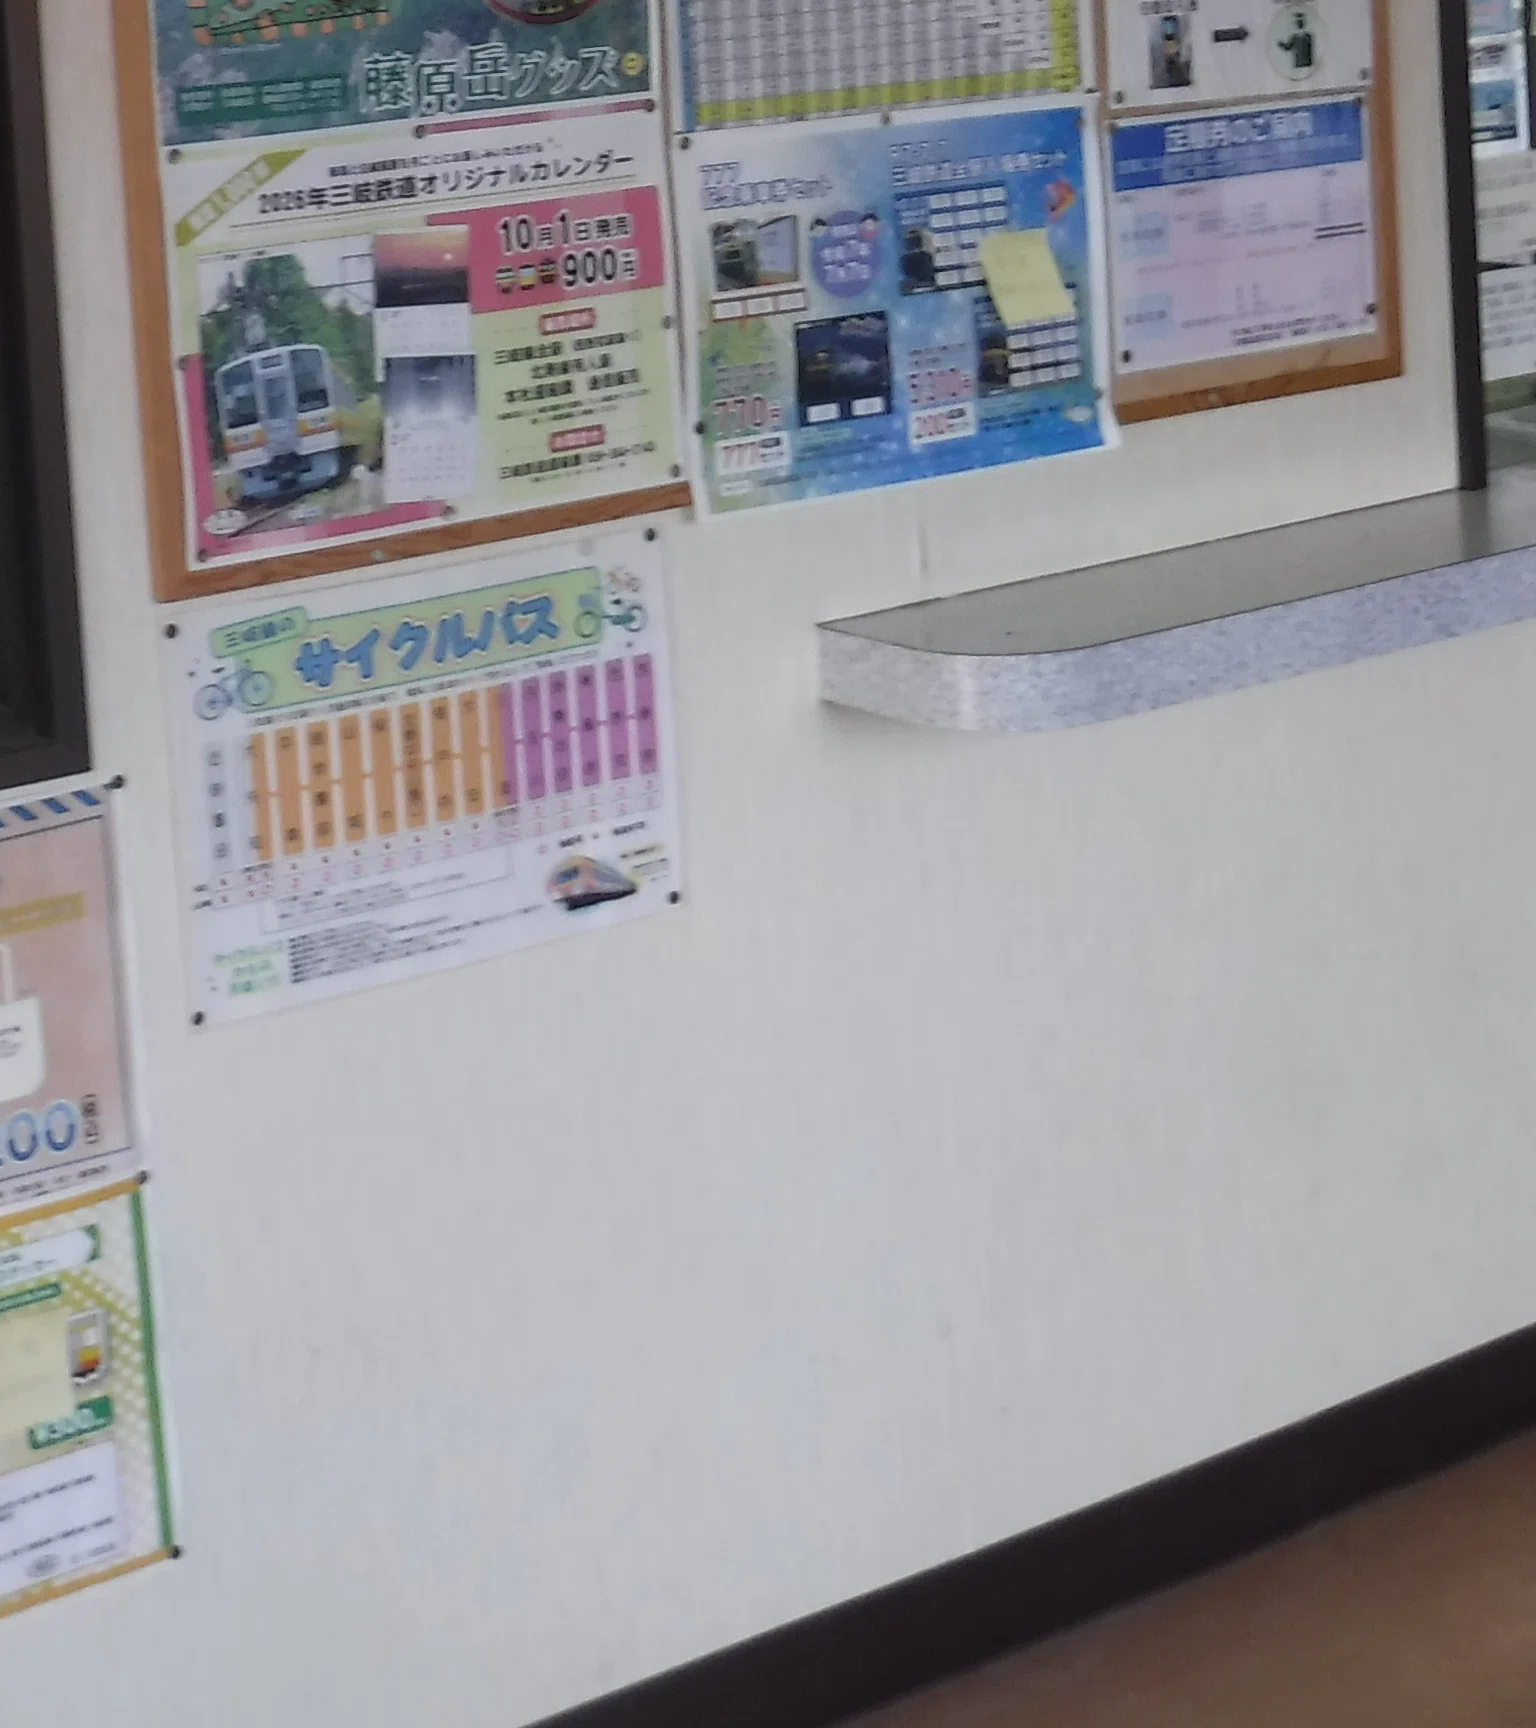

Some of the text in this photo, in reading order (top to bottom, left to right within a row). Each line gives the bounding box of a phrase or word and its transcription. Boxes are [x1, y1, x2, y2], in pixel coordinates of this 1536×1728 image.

[361, 39, 620, 117] 藤原岳グッズ
[500, 210, 632, 254] 10月1日発売
[563, 247, 638, 289] 900円
